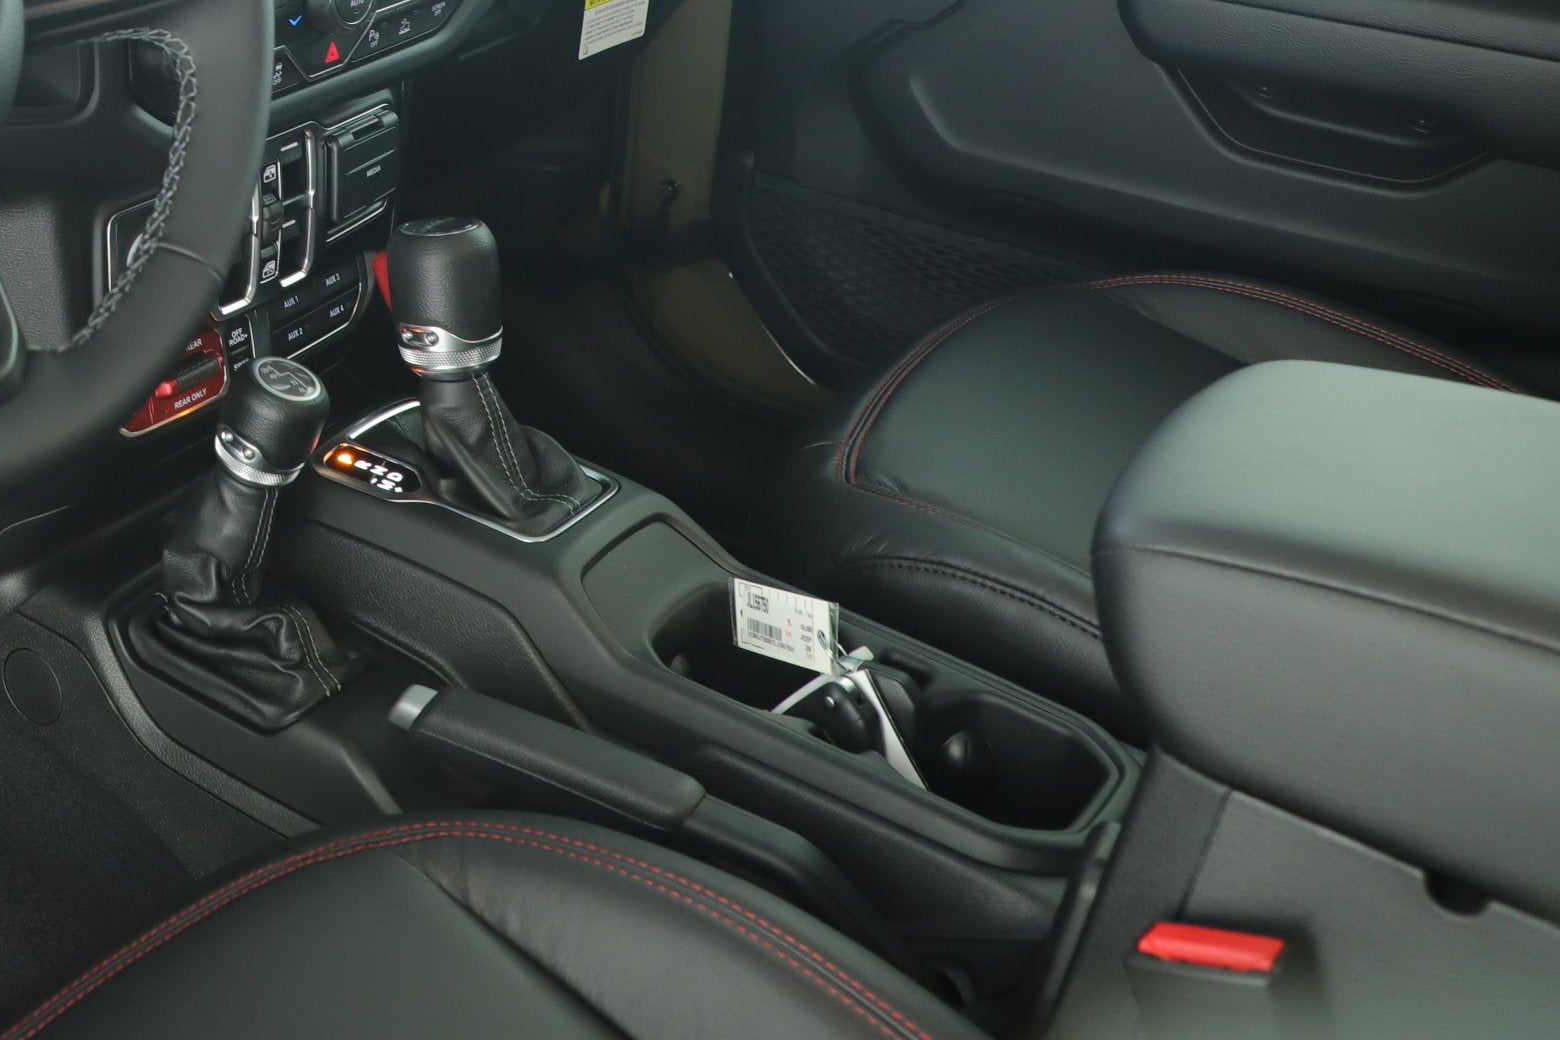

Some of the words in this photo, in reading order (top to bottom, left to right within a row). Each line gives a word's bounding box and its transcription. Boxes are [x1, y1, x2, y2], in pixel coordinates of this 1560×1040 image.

[366, 164, 382, 178] MEDIA
[325, 274, 336, 287] AUX
[283, 297, 295, 309] AUX
[329, 307, 340, 318] AUX
[231, 327, 243, 339] OFF
[287, 329, 299, 341] AUX
[228, 333, 248, 347] ROAD+
[174, 396, 191, 410] REAR
[191, 388, 207, 401] ONLY
[386, 471, 403, 482] D
